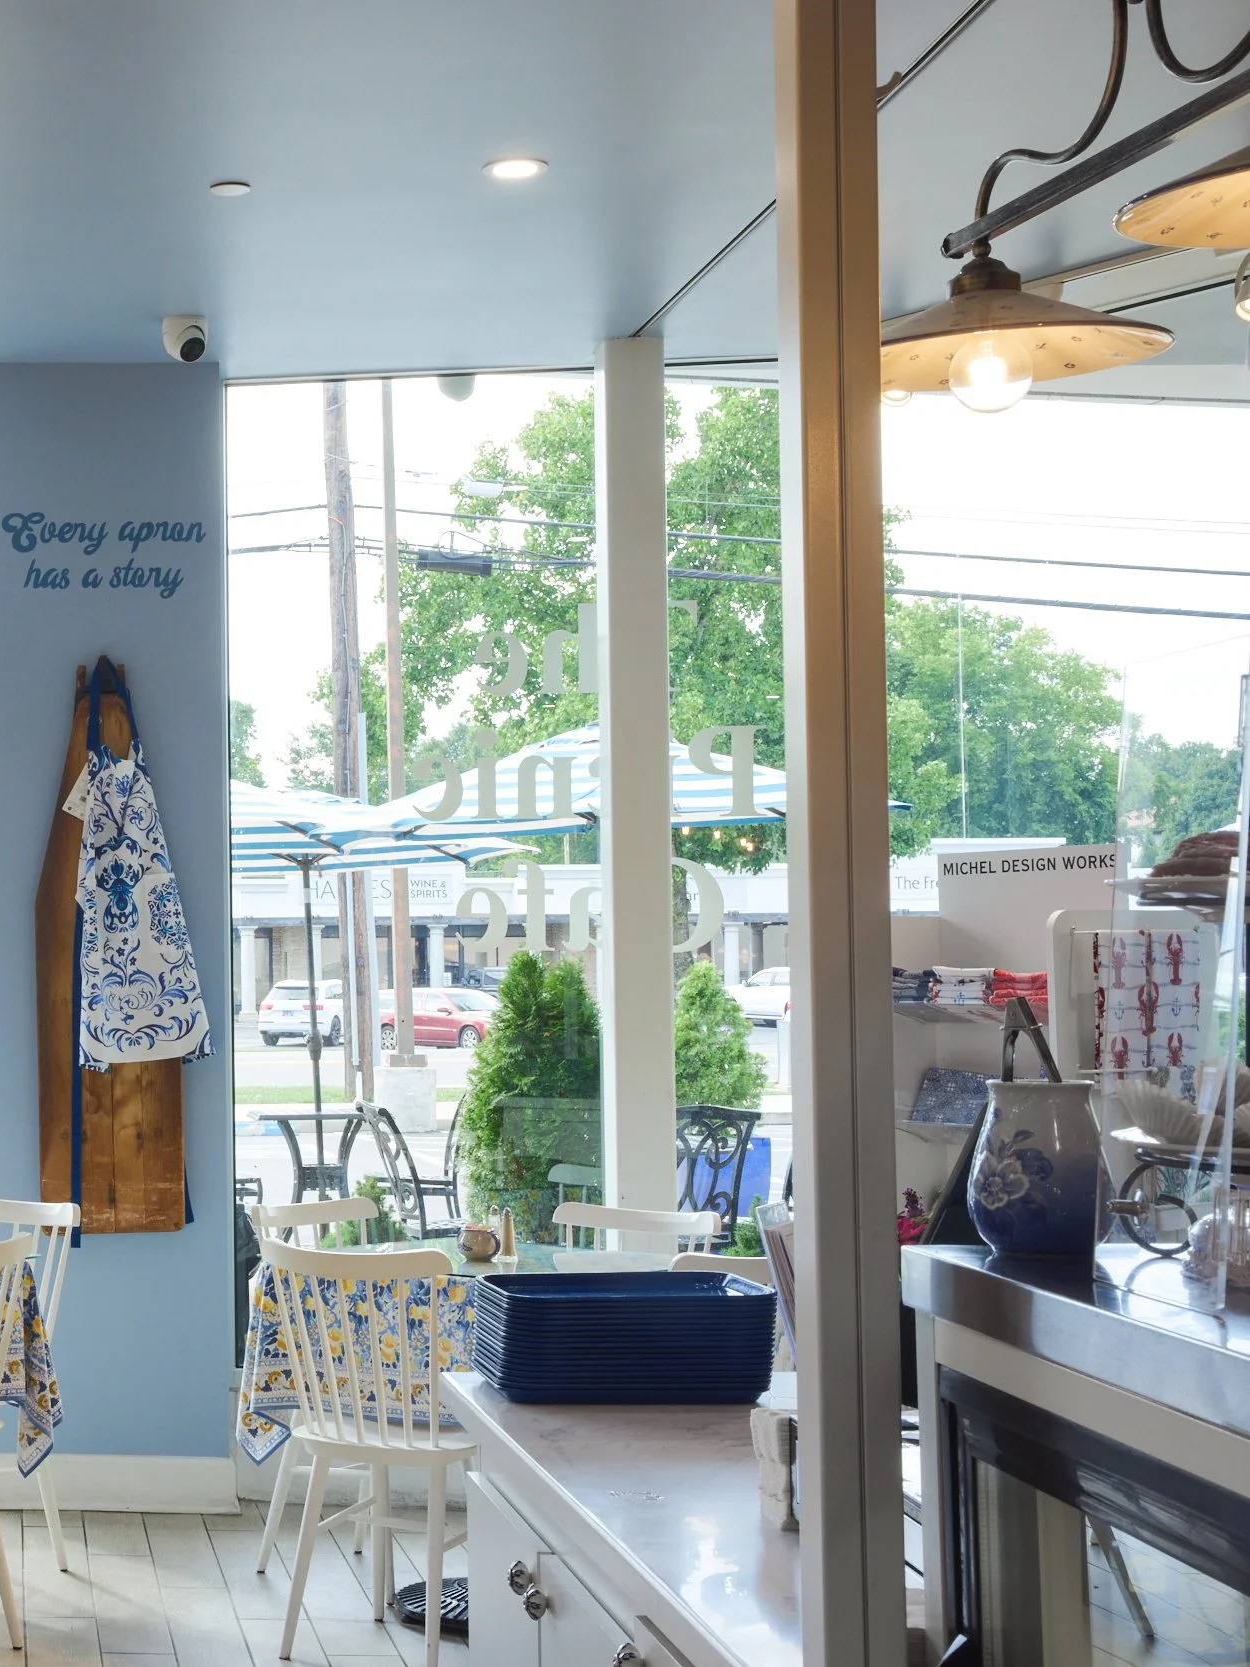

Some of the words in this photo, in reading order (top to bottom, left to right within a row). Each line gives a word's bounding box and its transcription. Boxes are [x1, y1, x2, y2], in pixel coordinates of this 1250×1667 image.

[1, 511, 109, 556] Every
[117, 520, 206, 554] apron
[23, 558, 71, 590] has
[81, 567, 103, 589] a
[108, 557, 185, 600] story
[943, 860, 997, 876] MICHEL
[1001, 857, 1057, 874] DESIGN
[1062, 854, 1116, 870] WORKS
[410, 880, 438, 888] WINE
[894, 876, 920, 890] The
[410, 889, 448, 899] SPIRITS
